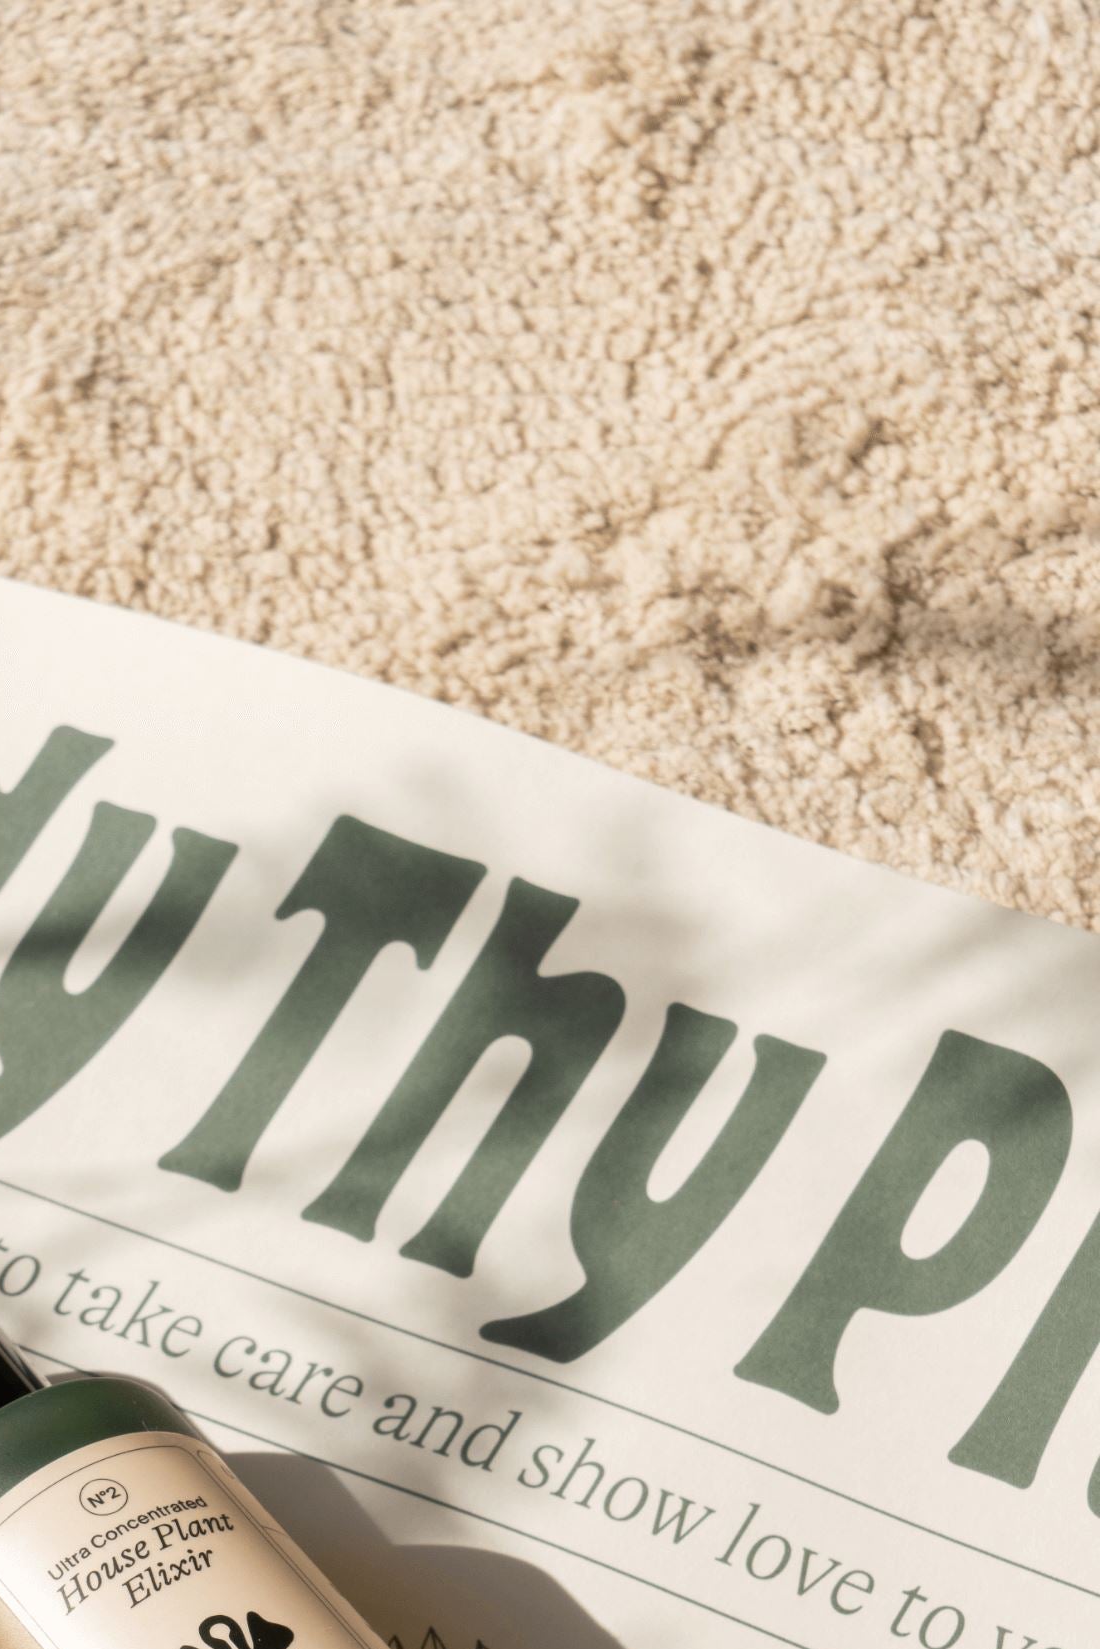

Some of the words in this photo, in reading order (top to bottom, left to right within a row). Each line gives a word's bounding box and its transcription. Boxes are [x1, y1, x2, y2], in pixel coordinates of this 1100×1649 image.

[157, 814, 828, 1364] Thy
[733, 1029, 1100, 1518] Pl
[53, 1269, 202, 1359] take
[213, 1334, 364, 1419] care
[373, 1393, 522, 1473] and
[517, 1439, 716, 1547] show
[716, 1502, 876, 1615] love
[47, 1547, 92, 1581] Ultra
[91, 1496, 208, 1549] Concentrated
[57, 1540, 150, 1616] House
[152, 1513, 234, 1550] Plant
[122, 1549, 213, 1608] Elixir
